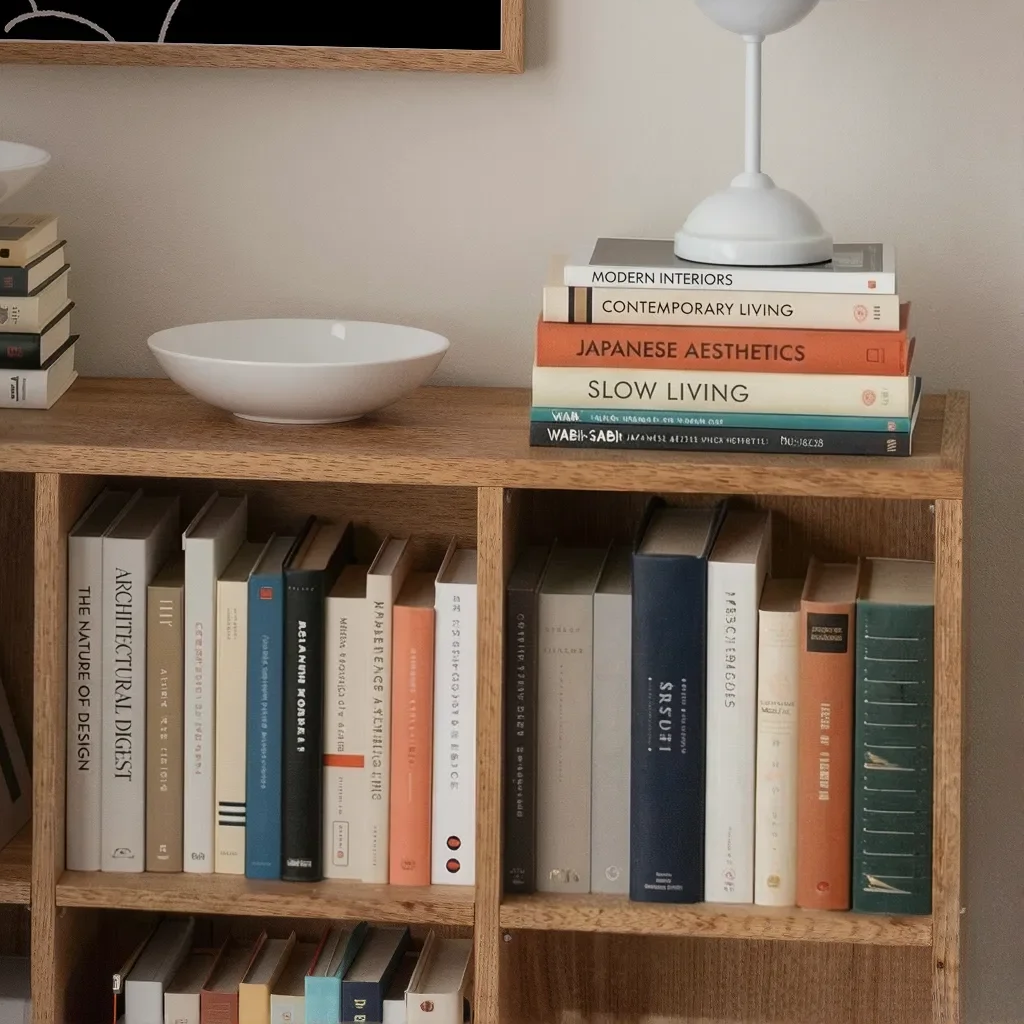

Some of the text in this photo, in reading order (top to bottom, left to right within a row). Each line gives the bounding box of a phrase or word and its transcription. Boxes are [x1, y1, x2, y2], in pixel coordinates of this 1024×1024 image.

[591, 270, 734, 287] MODERN INTERIORS
[601, 299, 794, 318] CONTEMPORARY LIVING
[575, 338, 806, 363] JAPANESE AESTHETICS
[587, 379, 749, 404] SLOW LIVING
[77, 585, 91, 772] THE NATURE OF DESIGN
[114, 567, 133, 783] ARCHITECTURAL DIGEST
